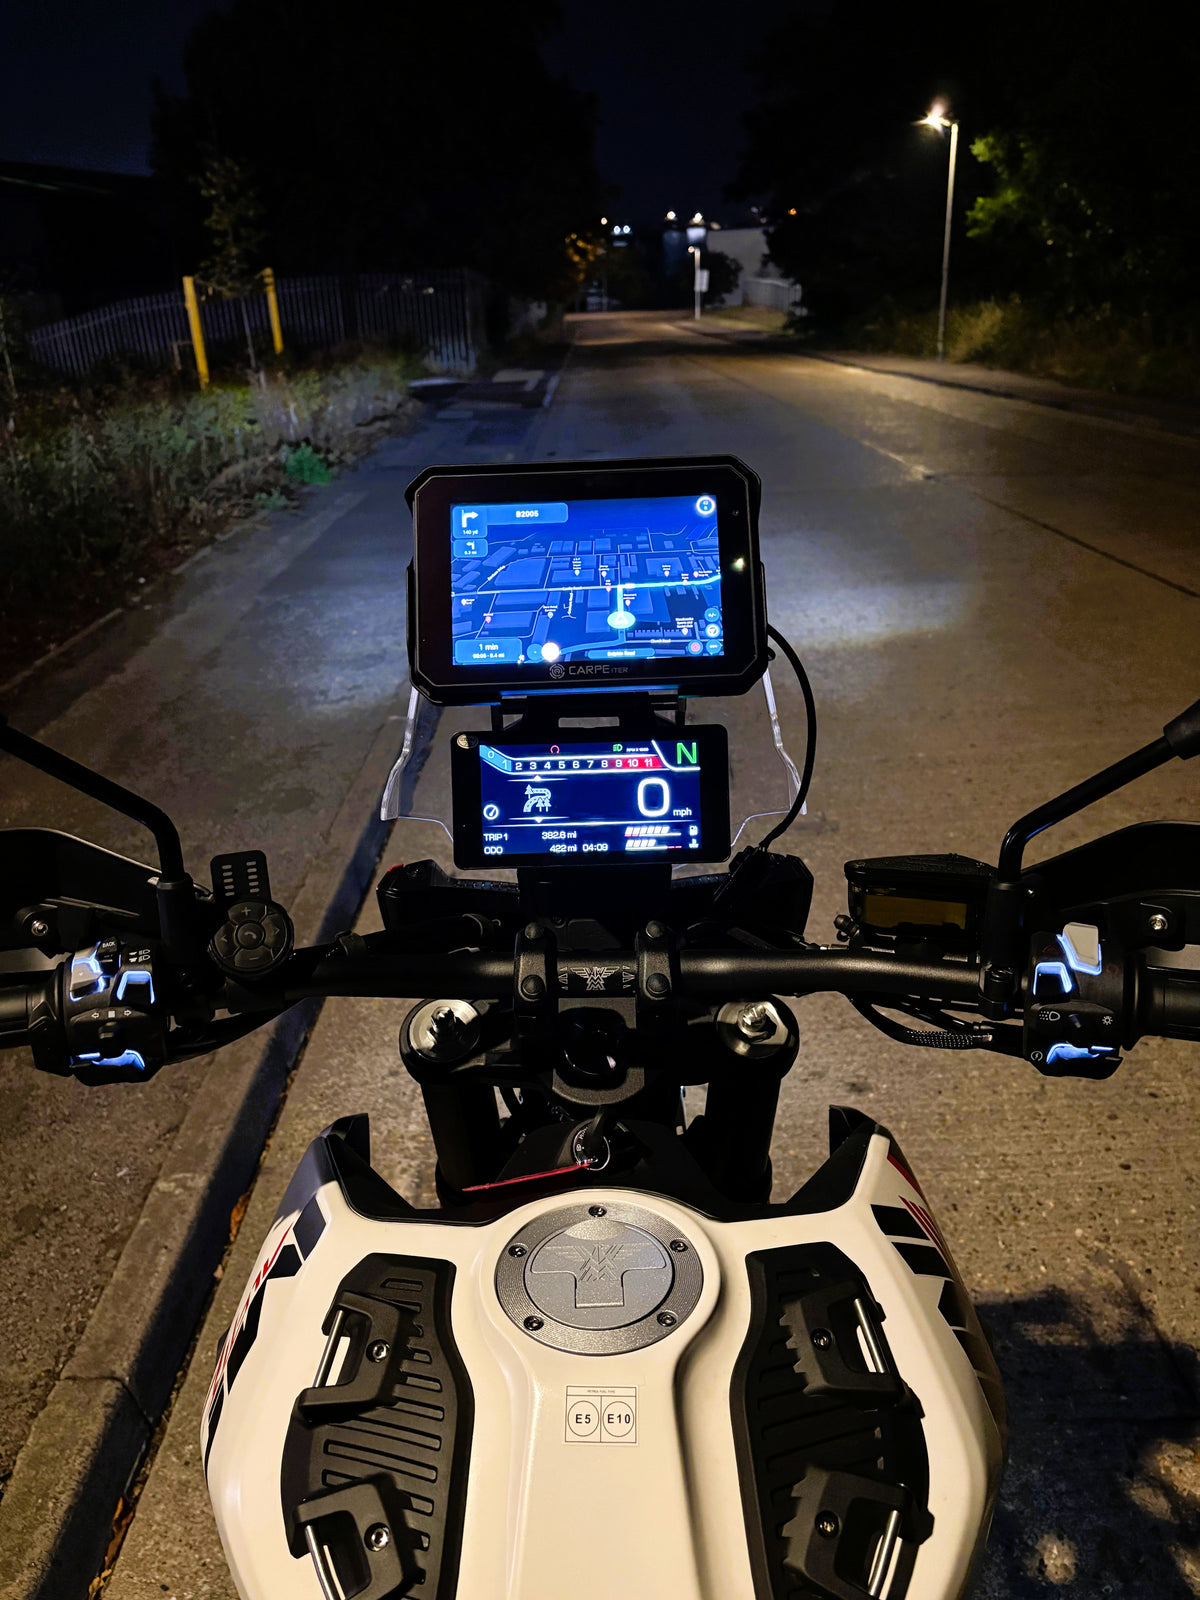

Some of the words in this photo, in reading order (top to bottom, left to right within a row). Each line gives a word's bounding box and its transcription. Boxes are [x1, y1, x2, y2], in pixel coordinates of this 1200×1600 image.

[515, 510, 540, 518] B2005
[479, 643, 483, 651] 1
[485, 643, 499, 651] min
[568, 664, 610, 675] CARPE
[676, 742, 697, 765] N
[487, 750, 495, 759] 0
[502, 759, 508, 770] 1
[515, 761, 523, 771] 2
[529, 761, 537, 770] 3
[543, 761, 551, 770] 4
[558, 760, 566, 769] 5
[572, 760, 580, 769] 6
[587, 760, 594, 769] 7
[601, 759, 609, 768] 8
[615, 759, 623, 768] 9
[627, 758, 639, 767] 10
[644, 758, 653, 767] 11
[637, 777, 670, 817] 0
[673, 807, 692, 818] mph
[483, 833, 503, 841] TRIP
[503, 832, 508, 841] 1
[567, 830, 577, 839] mi
[483, 846, 503, 855] ODO
[549, 844, 567, 853] 422
[567, 843, 577, 852] mi
[582, 843, 609, 852] 04:09
[575, 1413, 591, 1425] E5
[607, 1413, 631, 1425] E10
